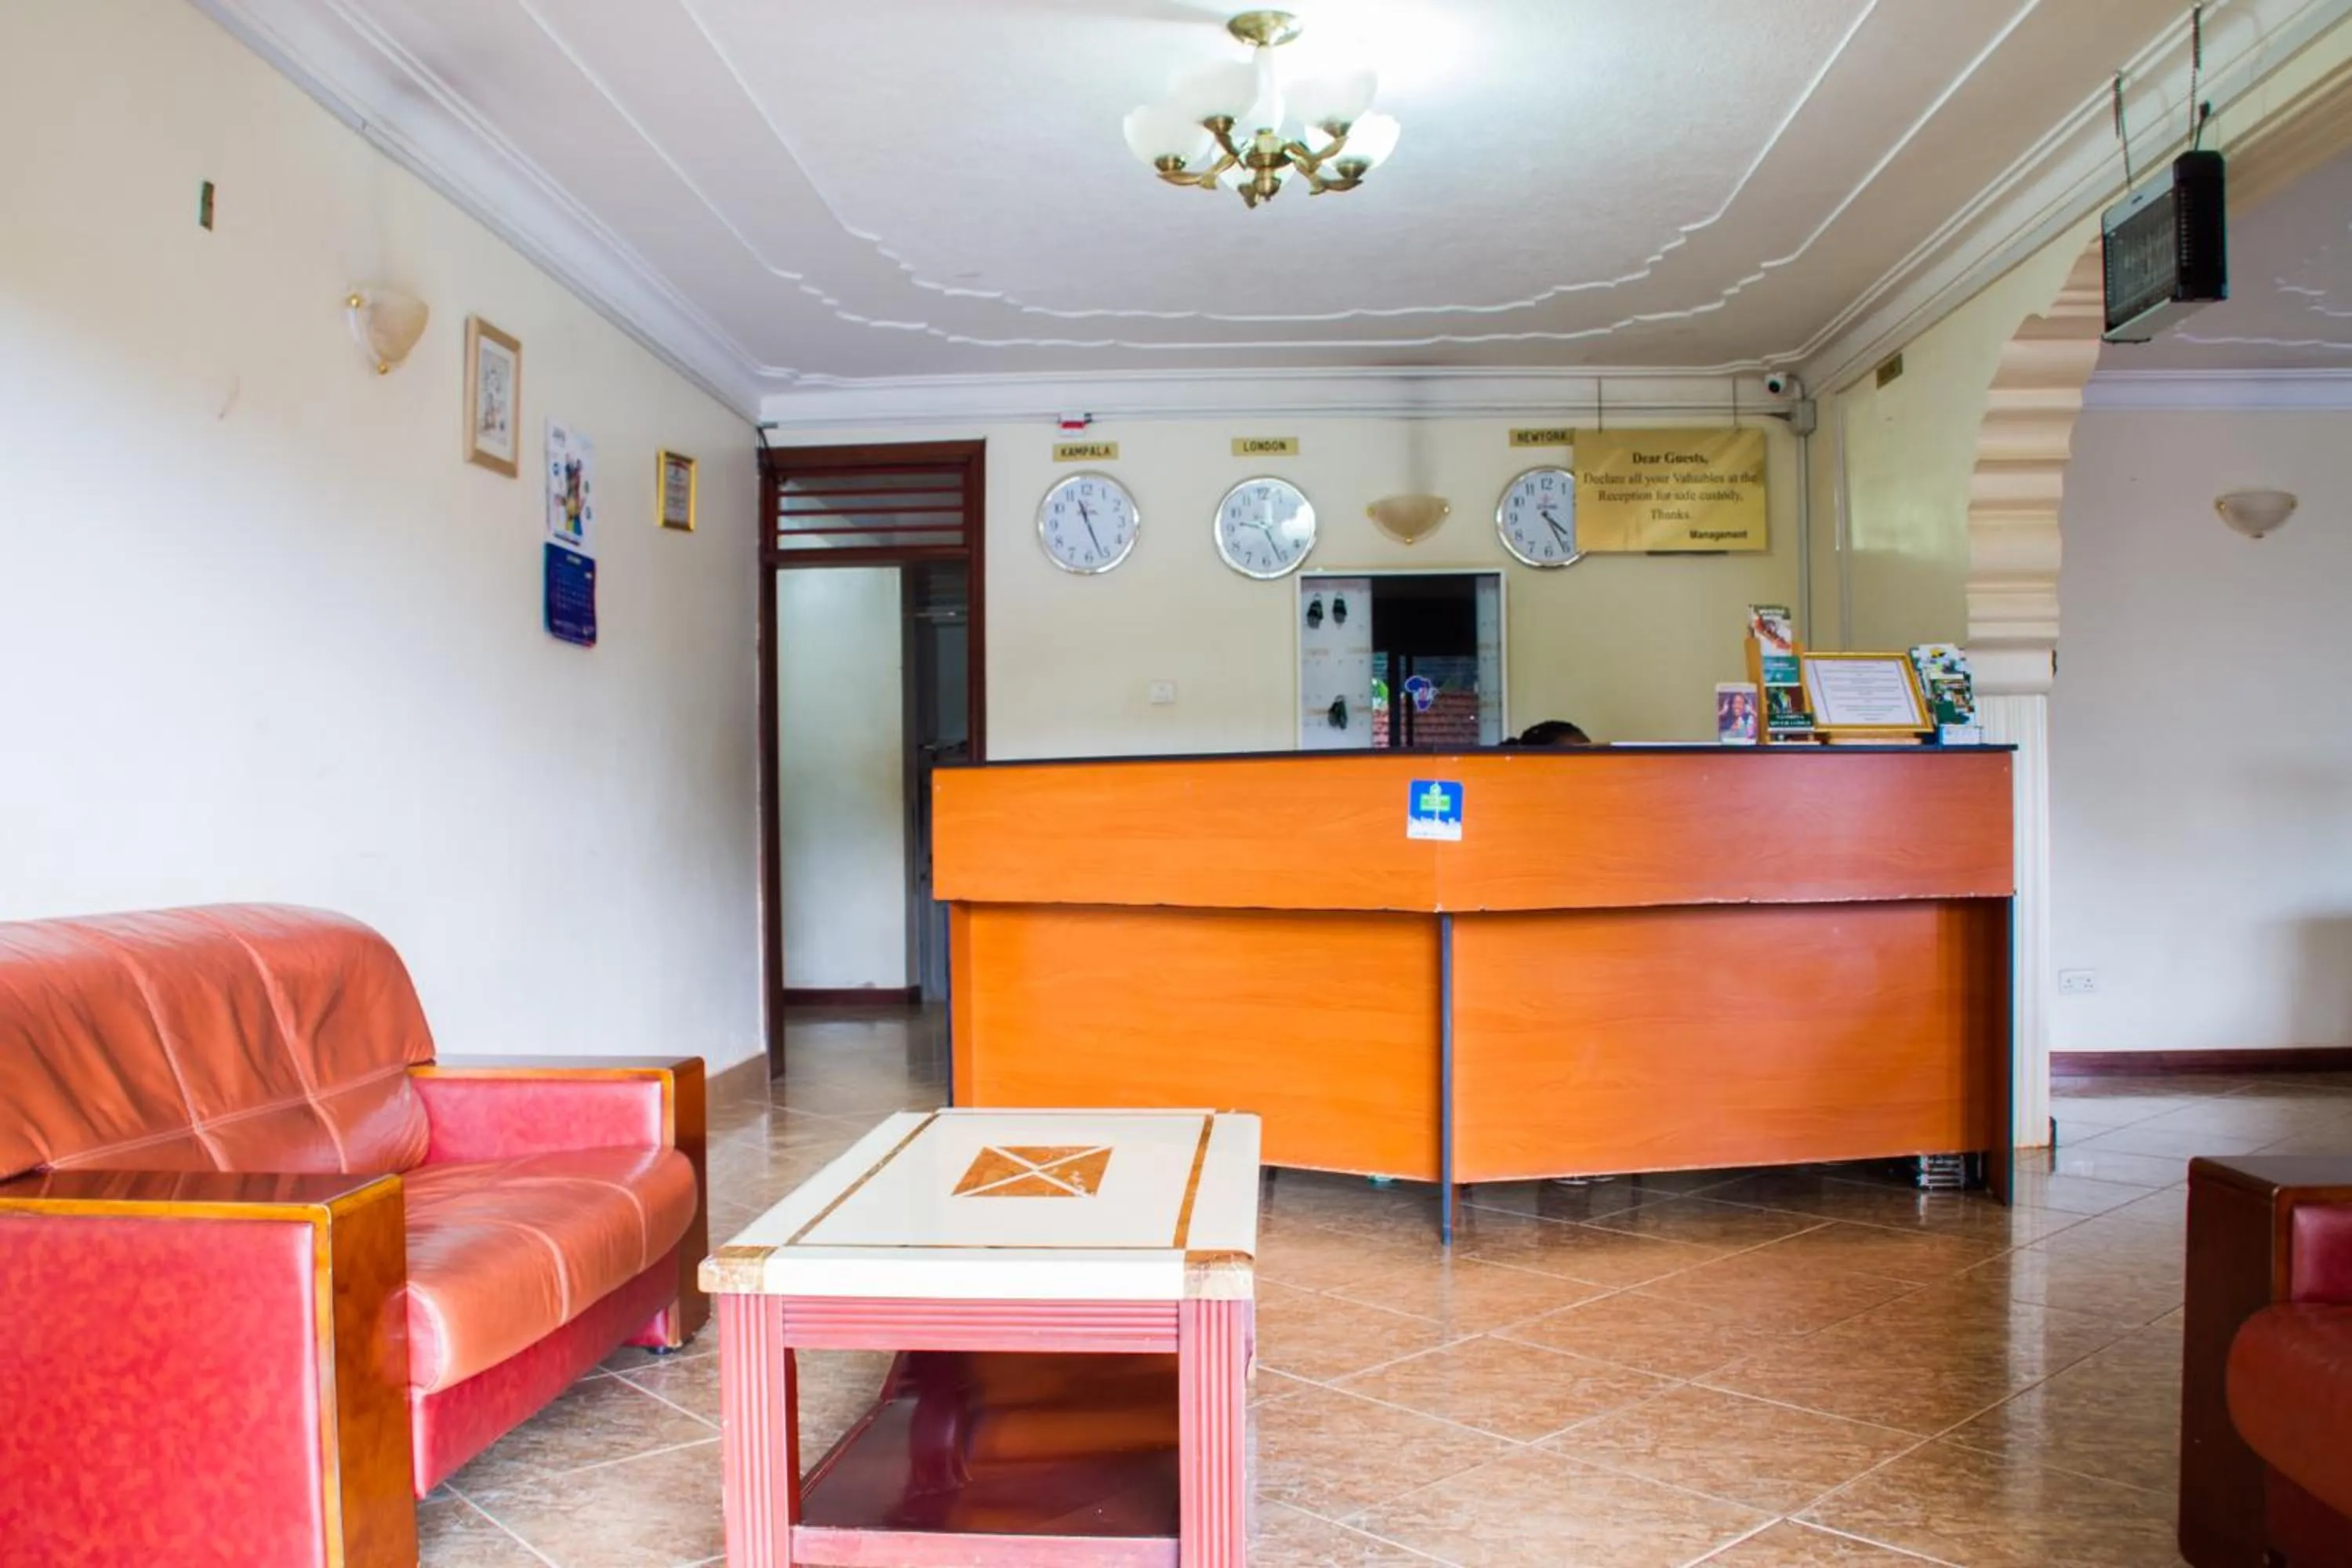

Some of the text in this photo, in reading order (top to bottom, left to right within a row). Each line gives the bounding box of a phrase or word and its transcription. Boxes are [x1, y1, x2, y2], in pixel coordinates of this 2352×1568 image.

[1517, 431, 1566, 443] NEWYORK
[1060, 445, 1111, 457] KAMPALA
[1243, 441, 1287, 452] LONDON
[1632, 452, 1661, 464] Dear
[1628, 472, 1642, 484] all
[1644, 475, 1670, 488] your
[1727, 474, 1738, 484] at
[1740, 472, 1758, 483] the
[1598, 490, 1651, 503] Reception
[1690, 530, 1748, 542] Management
